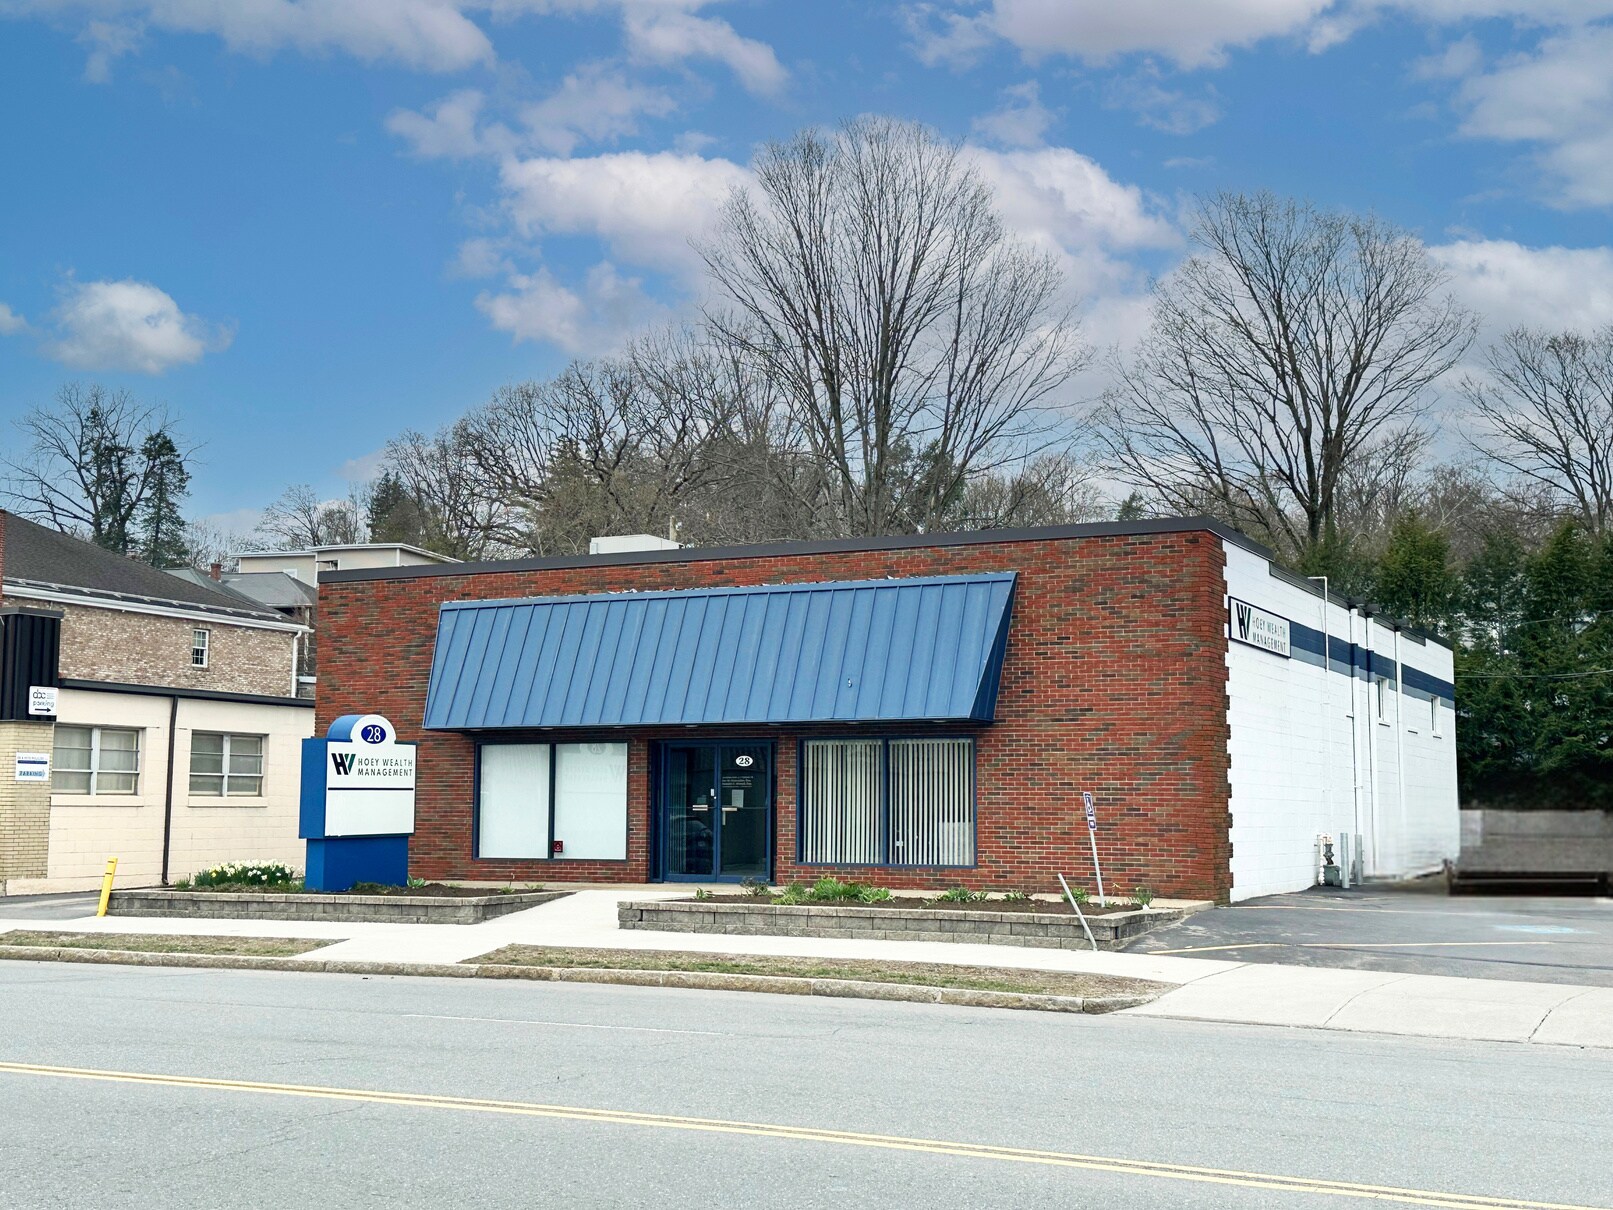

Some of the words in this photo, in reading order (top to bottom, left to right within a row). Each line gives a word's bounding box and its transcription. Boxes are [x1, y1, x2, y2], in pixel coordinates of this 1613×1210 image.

[1252, 633, 1286, 653] MANAGEMENT
[33, 700, 54, 708] parking
[367, 726, 381, 742] 28
[357, 758, 379, 766] HOEY
[382, 759, 413, 767] WEALTH
[738, 757, 750, 765] 28
[357, 768, 413, 776] MANAGEMENT
